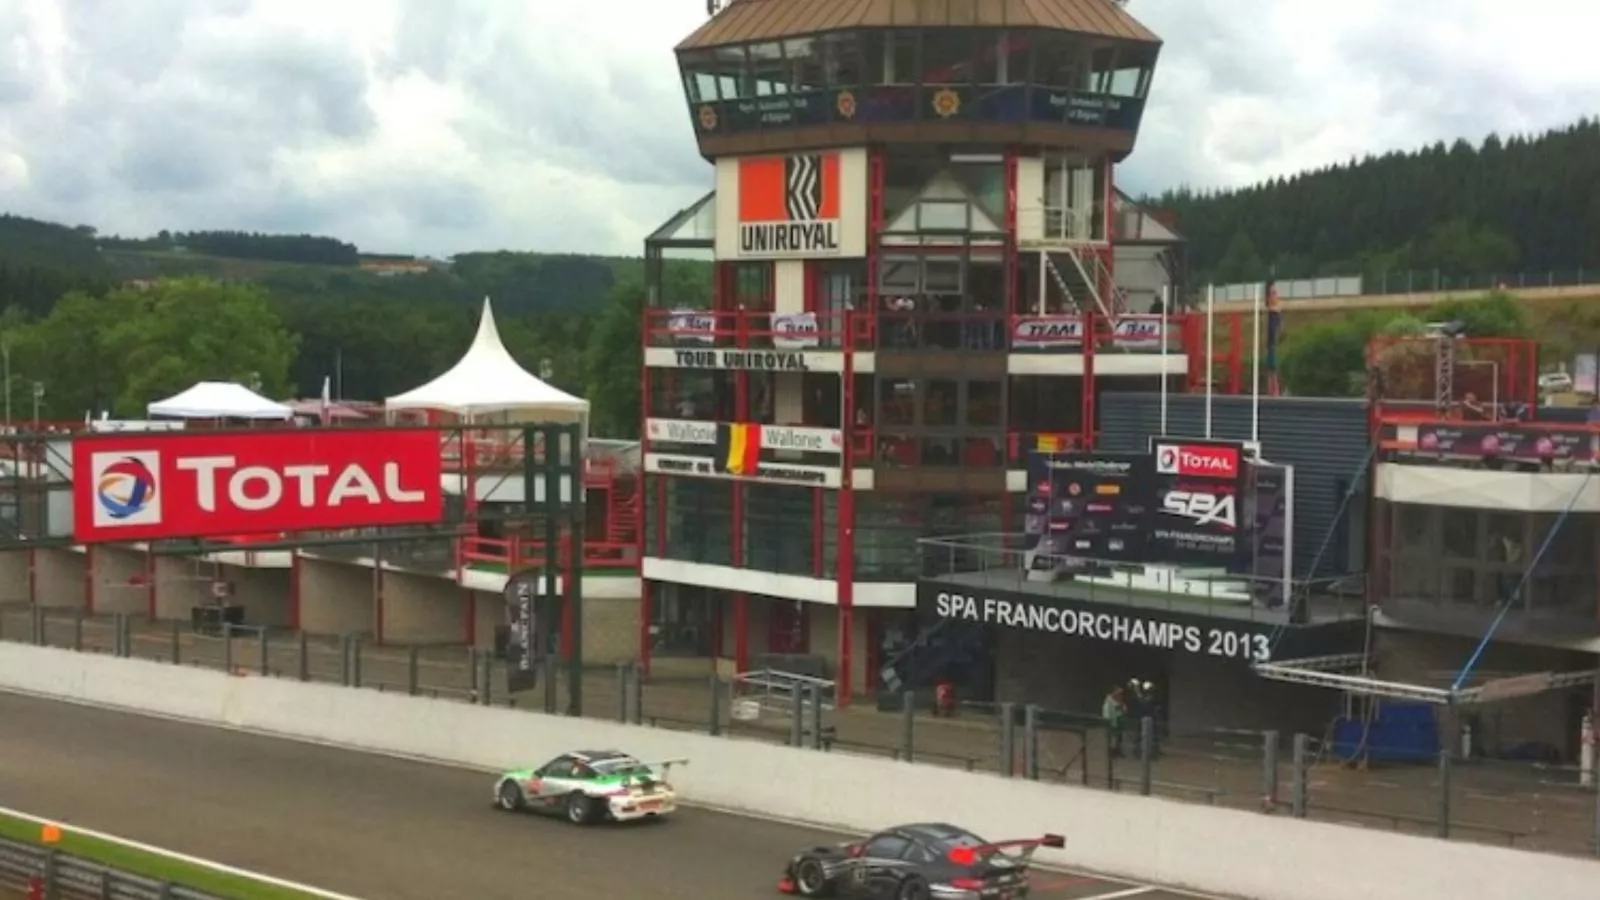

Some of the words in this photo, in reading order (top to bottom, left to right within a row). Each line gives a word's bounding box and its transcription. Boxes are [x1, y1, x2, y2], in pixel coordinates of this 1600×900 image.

[741, 222, 838, 251] UNIROYAL
[1028, 323, 1076, 336] TEAM
[675, 351, 717, 368] TOUR
[724, 352, 809, 371] UNIROYAL
[766, 428, 823, 449] Wallonie
[1180, 452, 1233, 471] TOTAL
[176, 455, 426, 513] TOTAL
[1163, 490, 1237, 528] SPA
[936, 592, 979, 622] SPA
[983, 598, 1202, 652] FRANCORCHAMPS
[1207, 628, 1271, 661] 2013
